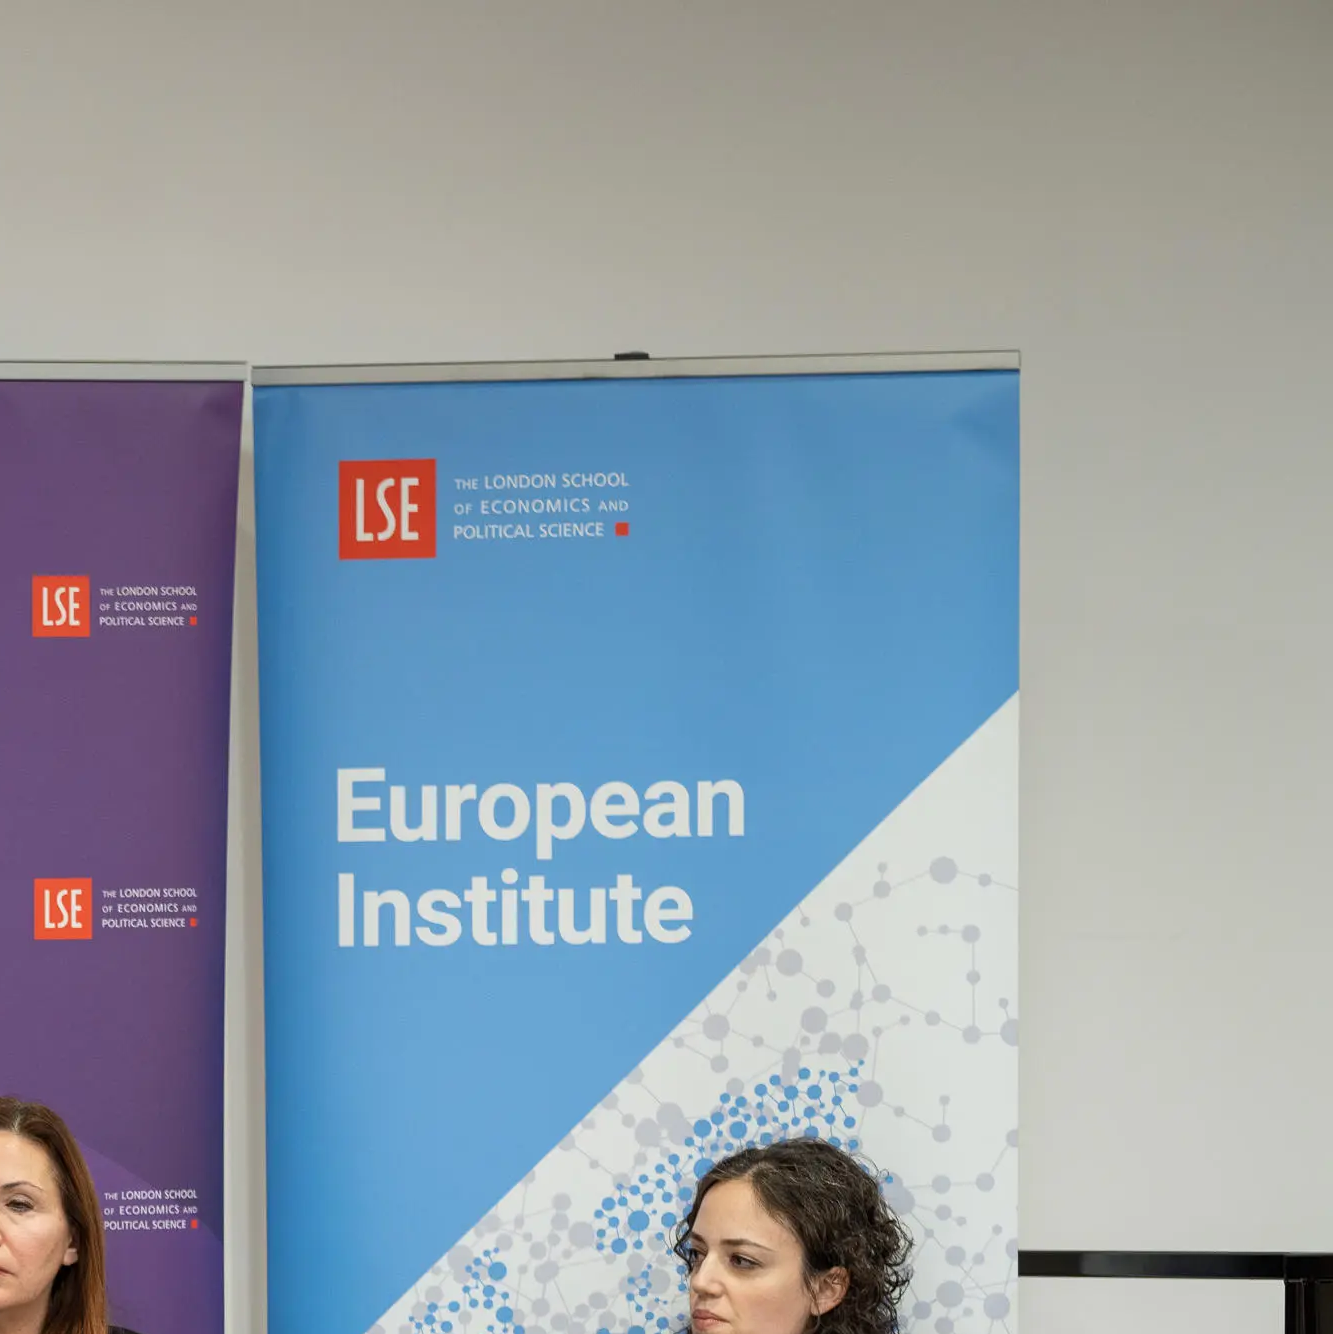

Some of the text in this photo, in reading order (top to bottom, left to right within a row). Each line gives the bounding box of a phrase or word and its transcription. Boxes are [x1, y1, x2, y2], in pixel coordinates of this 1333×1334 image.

[454, 471, 630, 491] THE LONDON SCHOOL
[355, 477, 420, 542] LSE
[453, 496, 629, 516] OF ECONOMICS AND
[453, 521, 604, 541] POLITICAL SCIENCE
[99, 585, 198, 597] THE LONDON SCHOOL
[42, 586, 81, 627] LSE
[99, 600, 198, 613] OF ECONOMICS AND
[98, 615, 185, 627] POLITICAL SCIENCE
[337, 767, 745, 861] European
[102, 887, 198, 899] THE LONDON SCHOOL
[44, 888, 83, 929] LSE
[101, 902, 197, 914] OF ECONOMICS AND
[338, 867, 694, 947] Institute
[101, 917, 186, 929] POLITICAL SCIENCE
[104, 1188, 198, 1202] THE LONDON SCHOOL
[103, 1203, 198, 1217] OF ECONOMICS AND
[103, 1218, 187, 1232] POLITICAL SCIENCE
